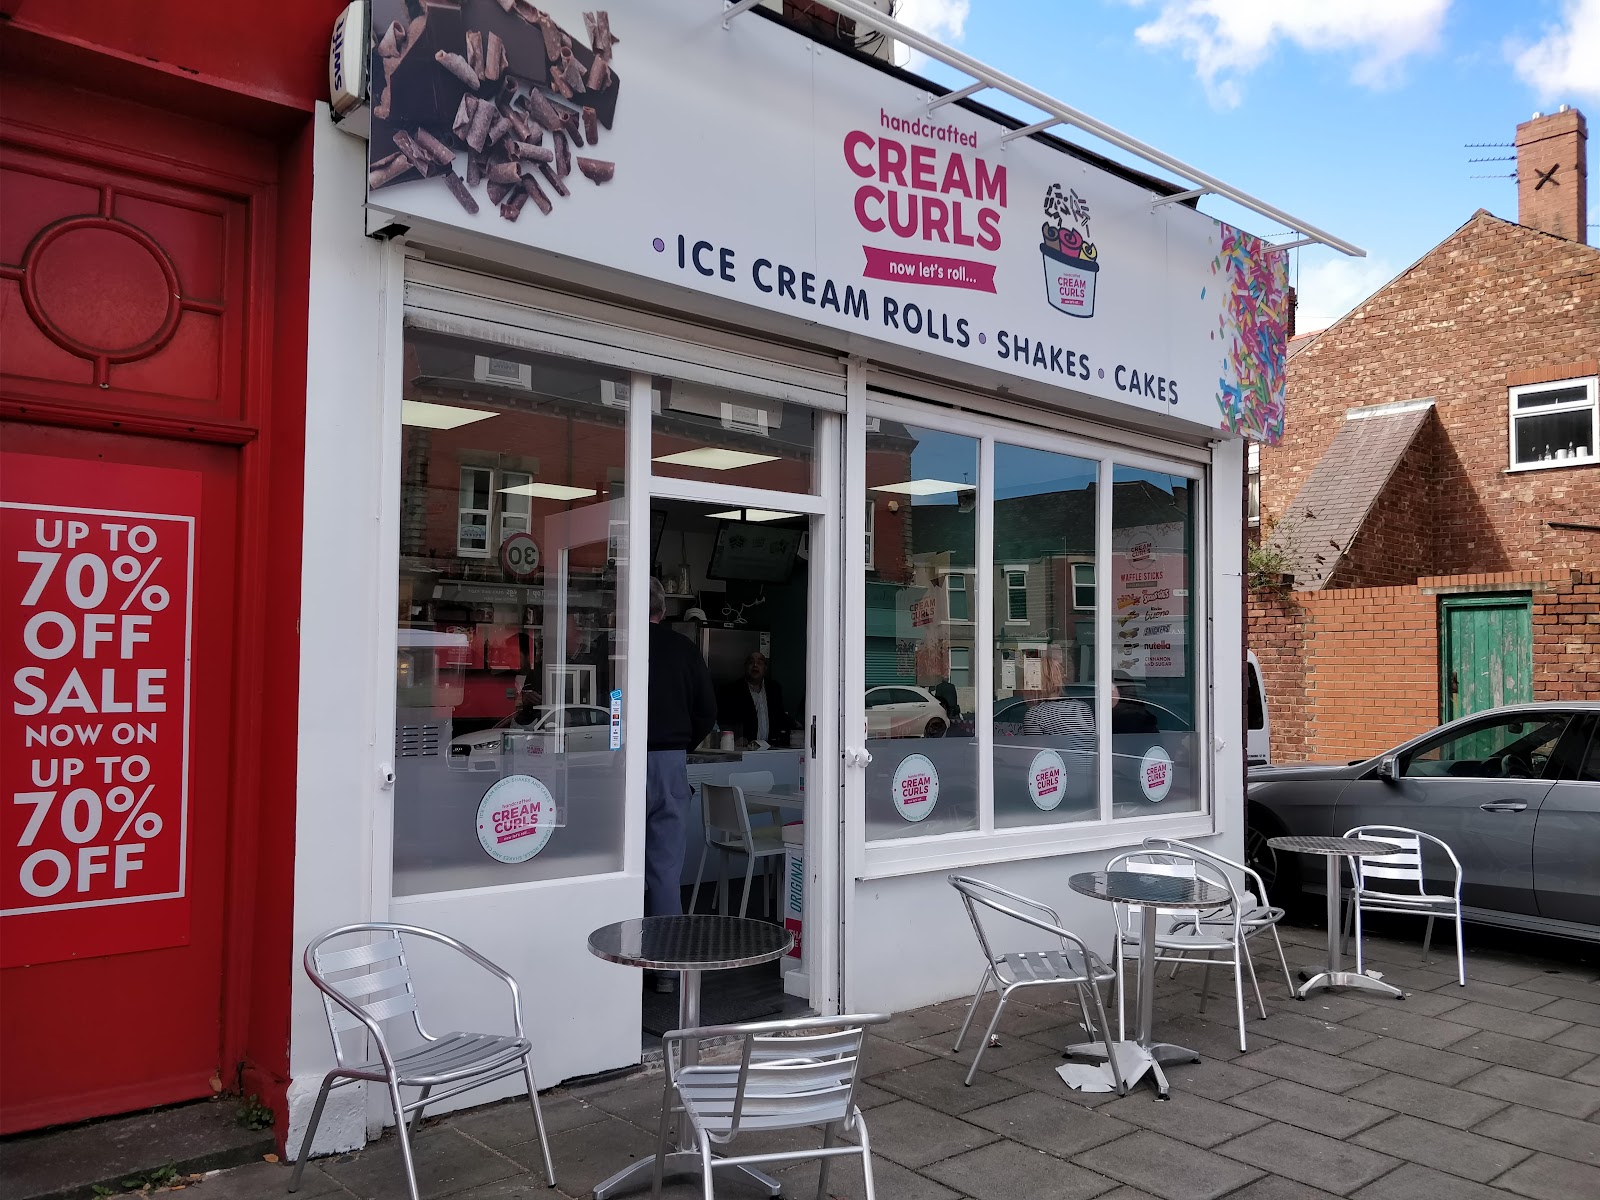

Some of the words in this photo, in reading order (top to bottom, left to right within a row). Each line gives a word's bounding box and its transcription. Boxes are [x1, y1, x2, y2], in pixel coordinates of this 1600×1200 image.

[880, 107, 977, 149] handcrafted
[843, 130, 1008, 208] CREAM
[854, 185, 1002, 252] CURLS
[889, 261, 915, 275] now
[919, 262, 944, 279] let's
[947, 267, 977, 284] roll...
[1057, 276, 1086, 289] CREAM
[1059, 287, 1085, 298] CURLS
[678, 234, 736, 282] ICE
[752, 258, 869, 320] CREAM
[883, 296, 971, 348] ROLLS
[997, 330, 1091, 381] SHAKES
[1114, 364, 1179, 405] CAKES
[35, 518, 90, 548] UP
[101, 523, 158, 554] TO
[17, 550, 171, 612] 70%
[1120, 572, 1142, 582] WAFFLE
[1143, 571, 1164, 581] STICKS
[909, 598, 936, 612] CREAM
[910, 608, 935, 621] CURLS
[23, 610, 153, 660] OFF
[1144, 640, 1171, 650] nutella
[13, 666, 168, 716] SALE
[25, 723, 103, 748] NOW
[111, 722, 157, 745] ON
[31, 758, 84, 788] UP
[96, 754, 151, 783] TO
[1035, 768, 1060, 782] CREAM
[1146, 763, 1167, 775] CREAM
[1147, 771, 1166, 782] CURLS
[901, 776, 931, 789] CREAM
[902, 785, 929, 797] CURLS
[1037, 776, 1059, 789] CURLS
[13, 784, 163, 844] 70%
[492, 802, 541, 823] CREAM
[494, 813, 539, 834] CURLS
[19, 842, 146, 898] OFF
[790, 856, 803, 913] ORIGINAL
